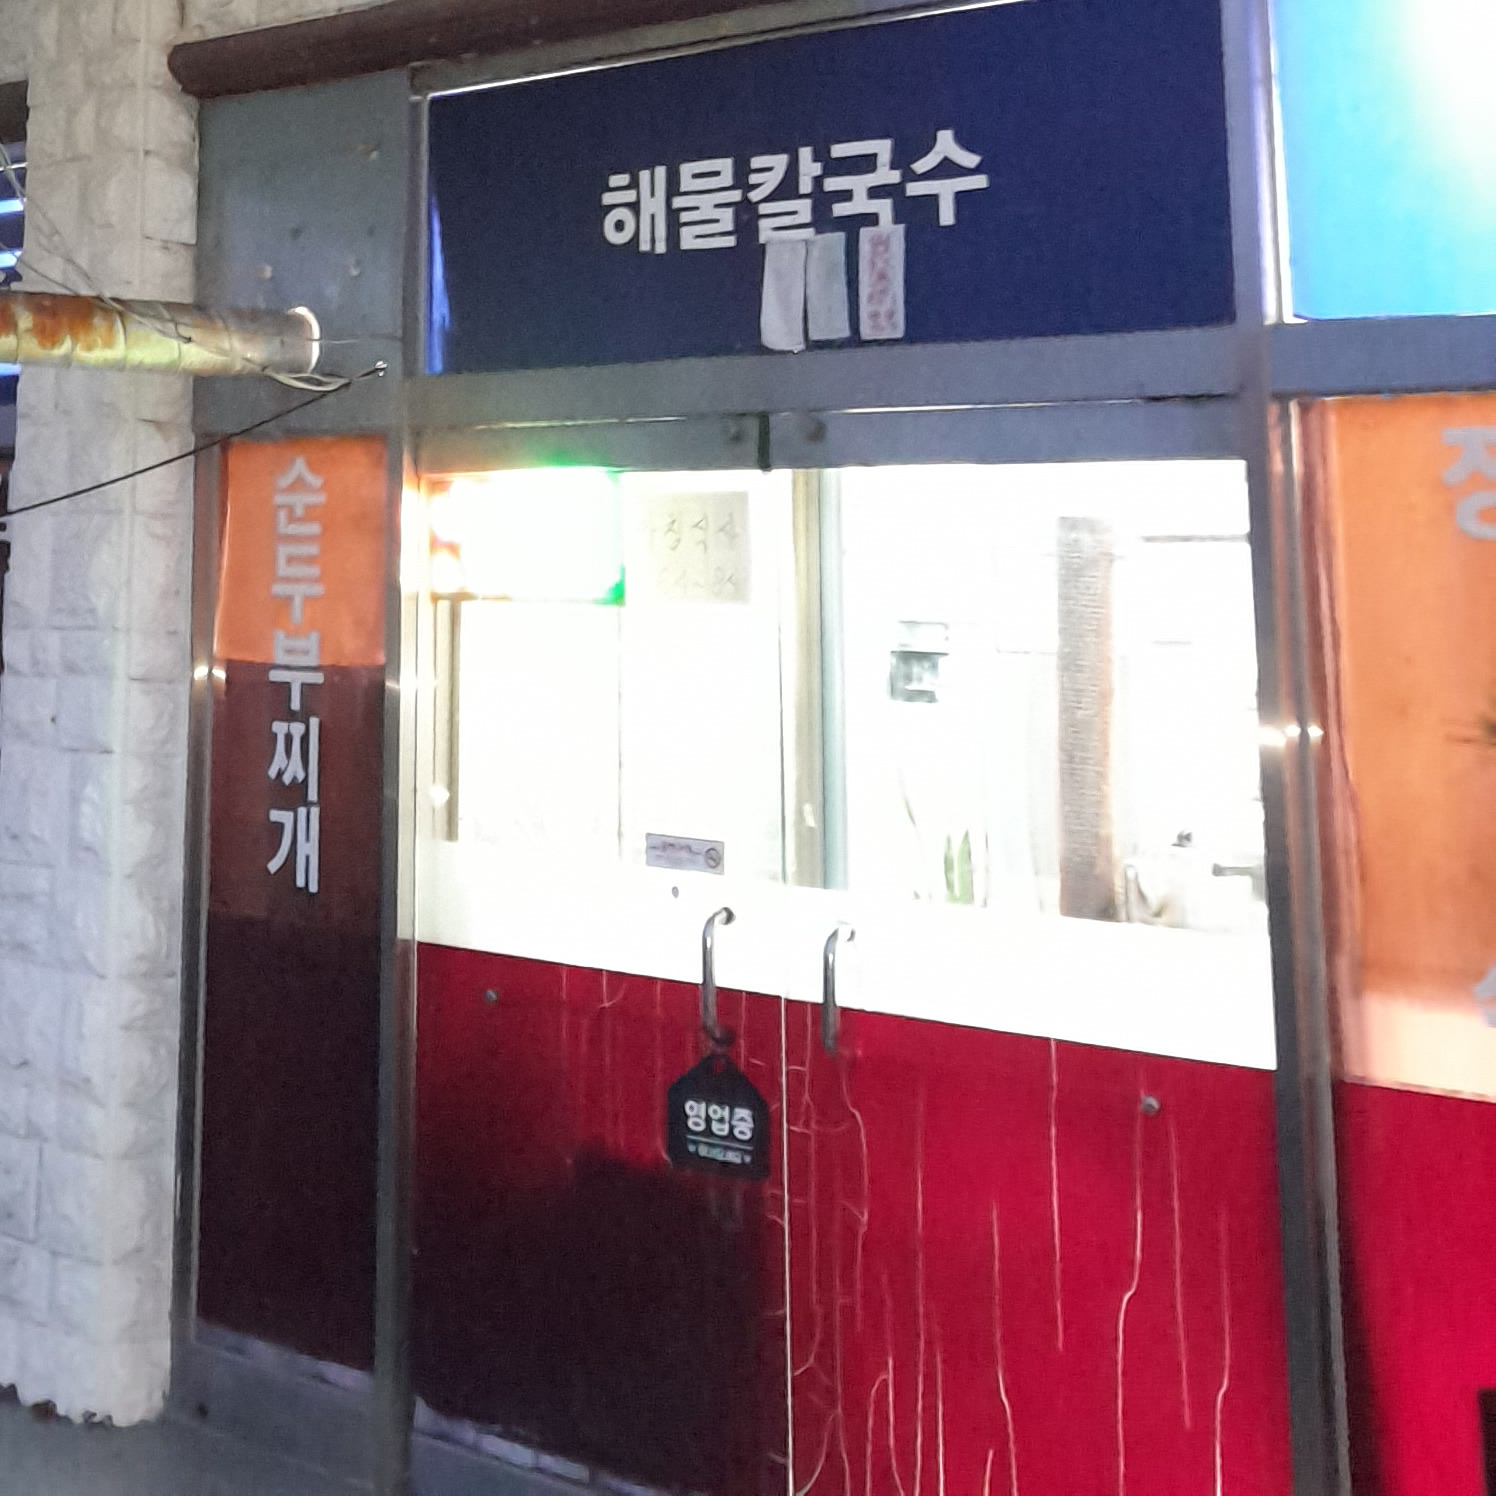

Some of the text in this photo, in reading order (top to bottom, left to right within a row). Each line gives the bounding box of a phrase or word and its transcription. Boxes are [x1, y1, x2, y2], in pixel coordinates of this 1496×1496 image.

[601, 129, 990, 254] 해물칼국수
[267, 456, 327, 894] 순두부찌개
[684, 1099, 755, 1141] 영업중
